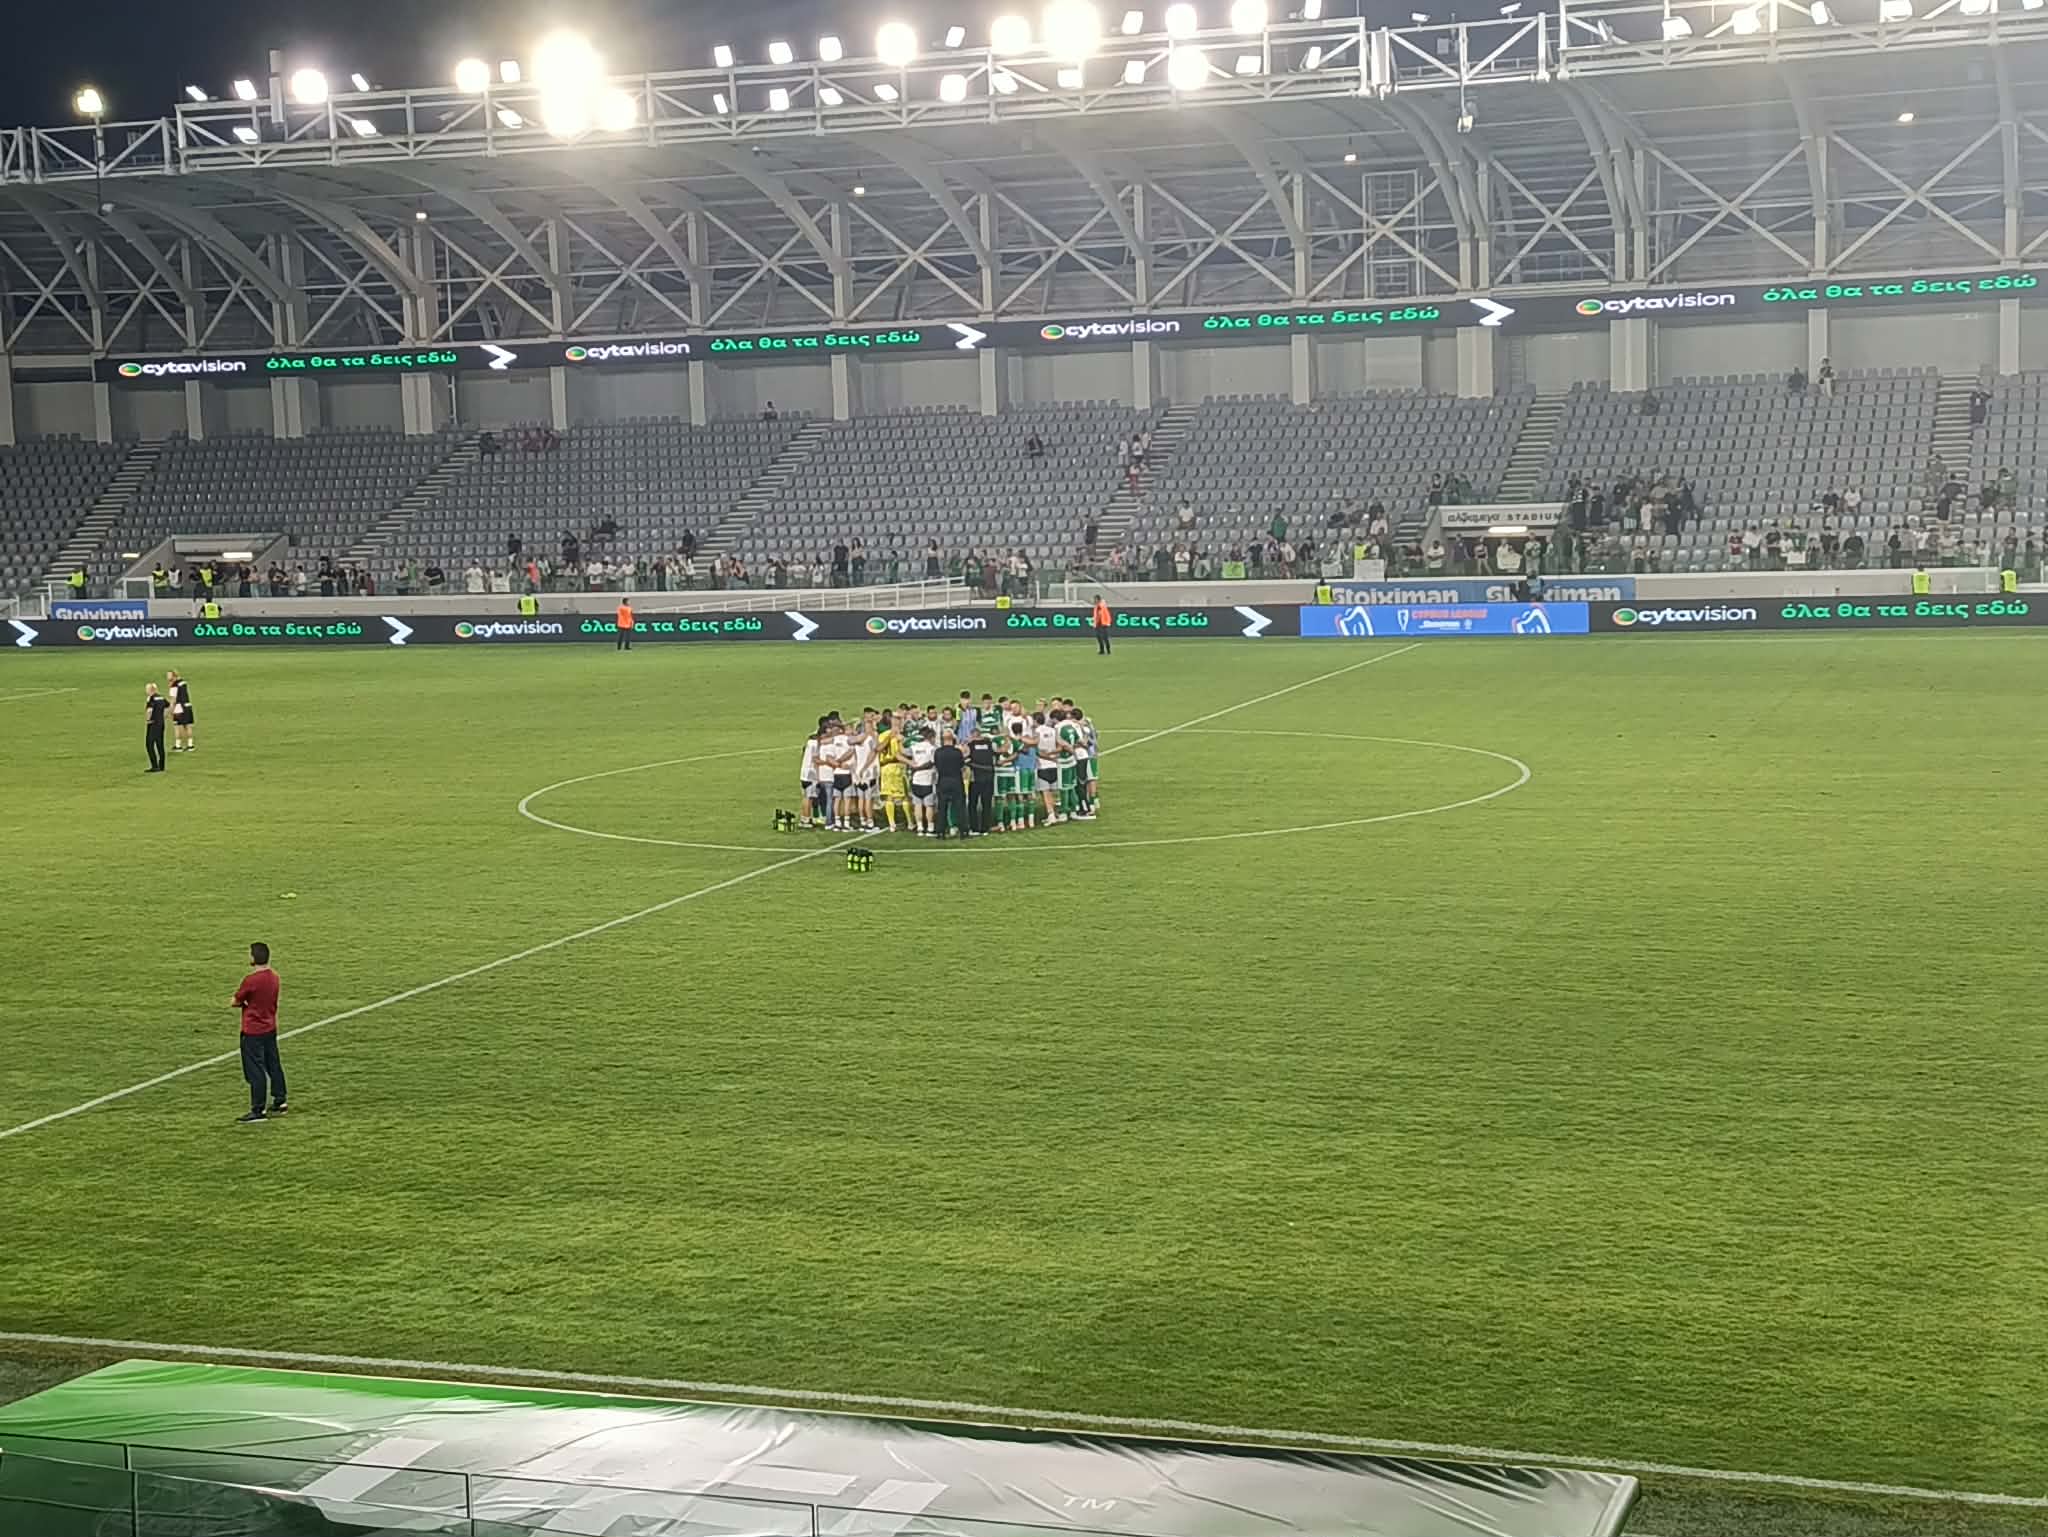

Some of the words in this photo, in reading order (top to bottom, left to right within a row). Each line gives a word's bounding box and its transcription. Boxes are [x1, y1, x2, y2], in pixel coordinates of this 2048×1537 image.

[1763, 287, 1818, 303] όλα
[1824, 284, 1863, 300] θα
[1870, 284, 1904, 296] τα
[1910, 279, 1971, 295] δεις
[1978, 275, 2038, 292] εδώ
[1604, 291, 1736, 314] cytavision
[1065, 318, 1181, 339] cytavision
[1202, 315, 1252, 332] όλα
[1256, 314, 1291, 329] θα
[1295, 314, 1327, 327] τα
[1330, 310, 1385, 326] δεις
[1388, 306, 1441, 323] εδώ
[587, 339, 690, 360] cytavision
[710, 338, 754, 353] όλα
[758, 336, 789, 351] θα
[792, 337, 820, 349] τα
[823, 334, 871, 349] δεις
[875, 331, 921, 346] εδώ
[142, 359, 247, 376] cytavision
[265, 357, 306, 369] όλα
[309, 356, 338, 368] θα
[341, 357, 366, 367] τα
[369, 353, 413, 367] δεις
[416, 351, 457, 364] εδώ
[1638, 605, 1757, 626] cytavision
[1780, 603, 1831, 619] όλα
[1836, 602, 1872, 619] θα
[1878, 605, 1909, 617] τα
[1914, 601, 1969, 619] δεις
[1974, 600, 2029, 617] εδώ
[193, 623, 230, 637] όλα
[231, 623, 257, 636] θα
[259, 626, 282, 636] τα
[284, 623, 323, 638] δεις
[325, 623, 362, 636] εδώ
[474, 620, 563, 638] cytavision
[580, 619, 618, 633] όλα
[651, 622, 675, 633] τα
[678, 618, 720, 634] δεις
[722, 618, 762, 633] εδώ
[887, 615, 987, 634] cytavision
[1006, 614, 1049, 629] όλα
[1052, 613, 1081, 628] θα
[1115, 613, 1161, 631] δεις
[1164, 612, 1209, 628] εδώ
[95, 624, 178, 641] cytavision
[1062, 1493, 1117, 1512] TM
